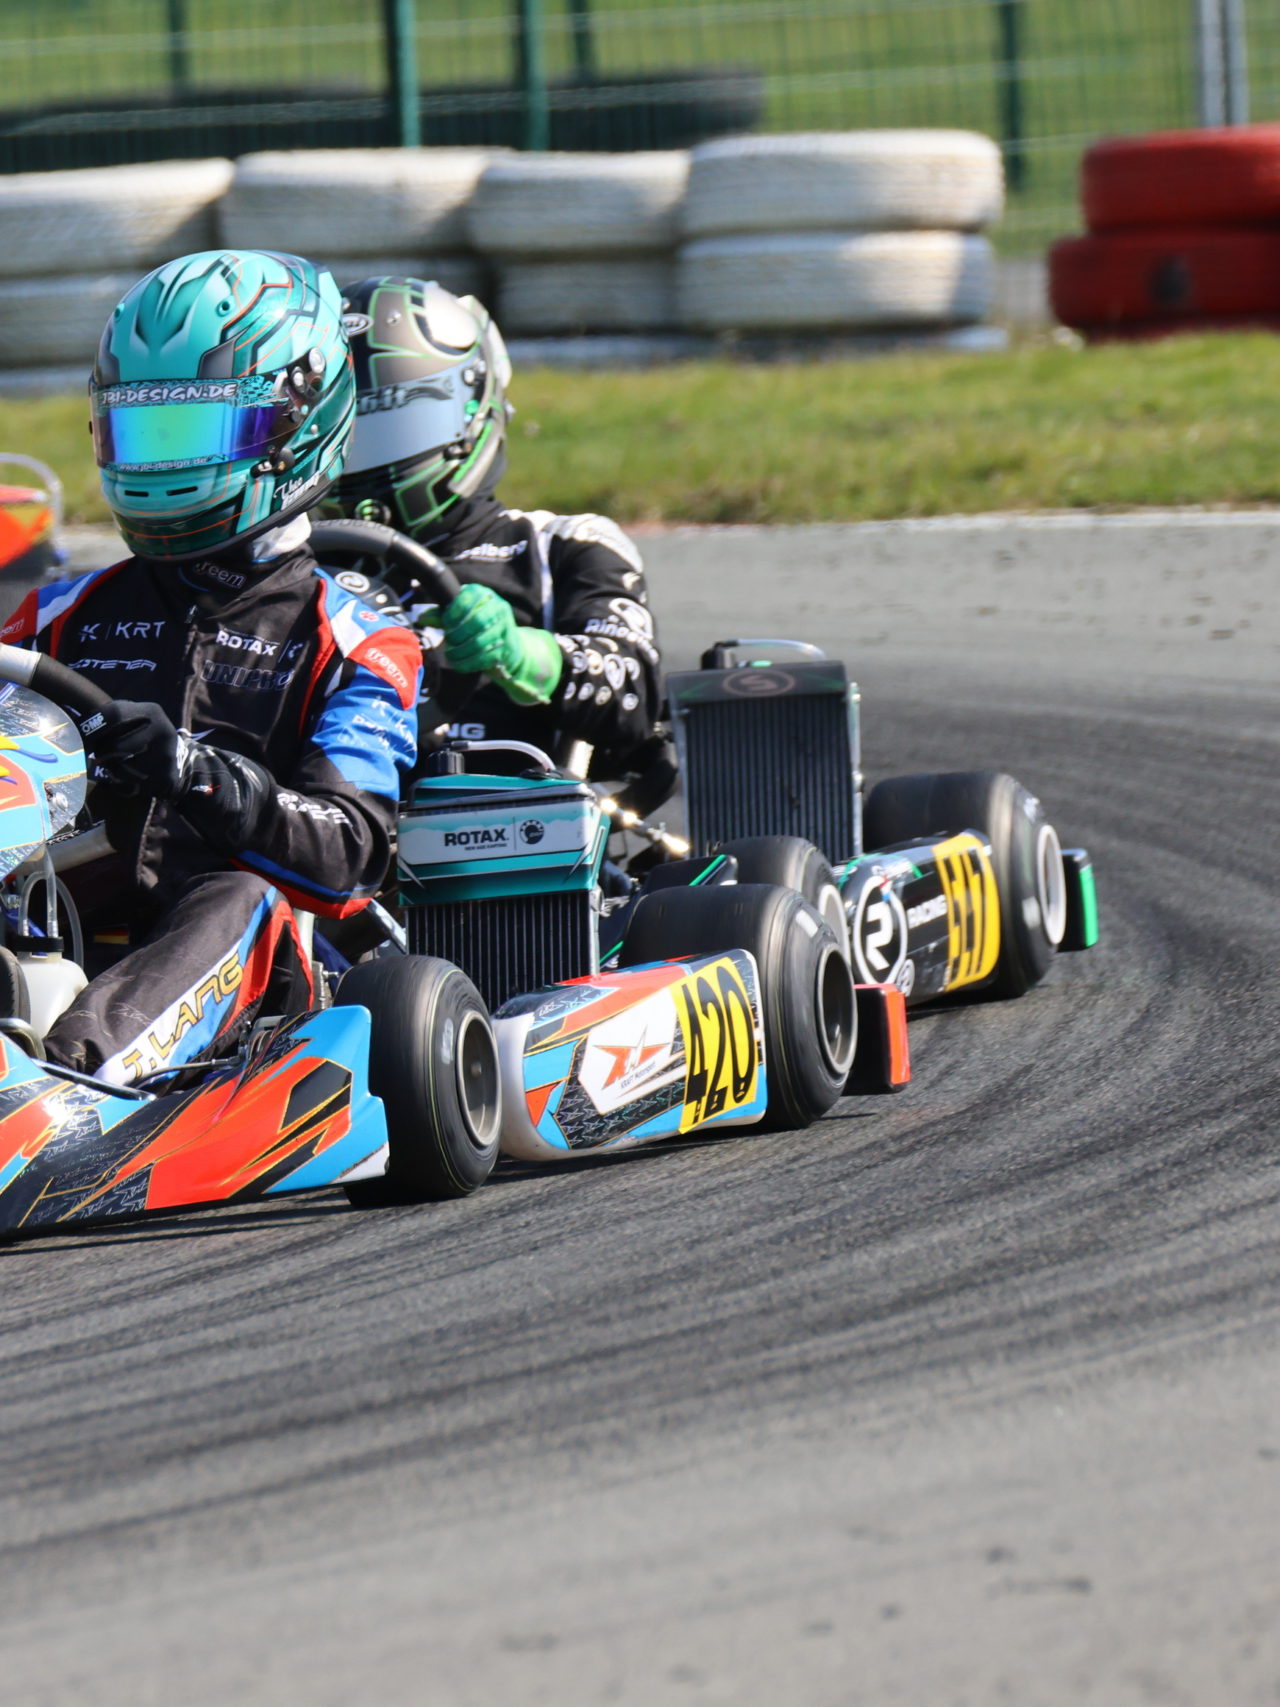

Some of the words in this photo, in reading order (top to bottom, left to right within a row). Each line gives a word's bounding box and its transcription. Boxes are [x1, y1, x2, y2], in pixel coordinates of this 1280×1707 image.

[102, 383, 238, 404] JBI-DESIGN.DE
[115, 621, 166, 639] KRT
[216, 630, 277, 656] ROTAX
[81, 714, 105, 734] OMP
[444, 828, 506, 847] ROTAX
[682, 966, 755, 1124] 420
